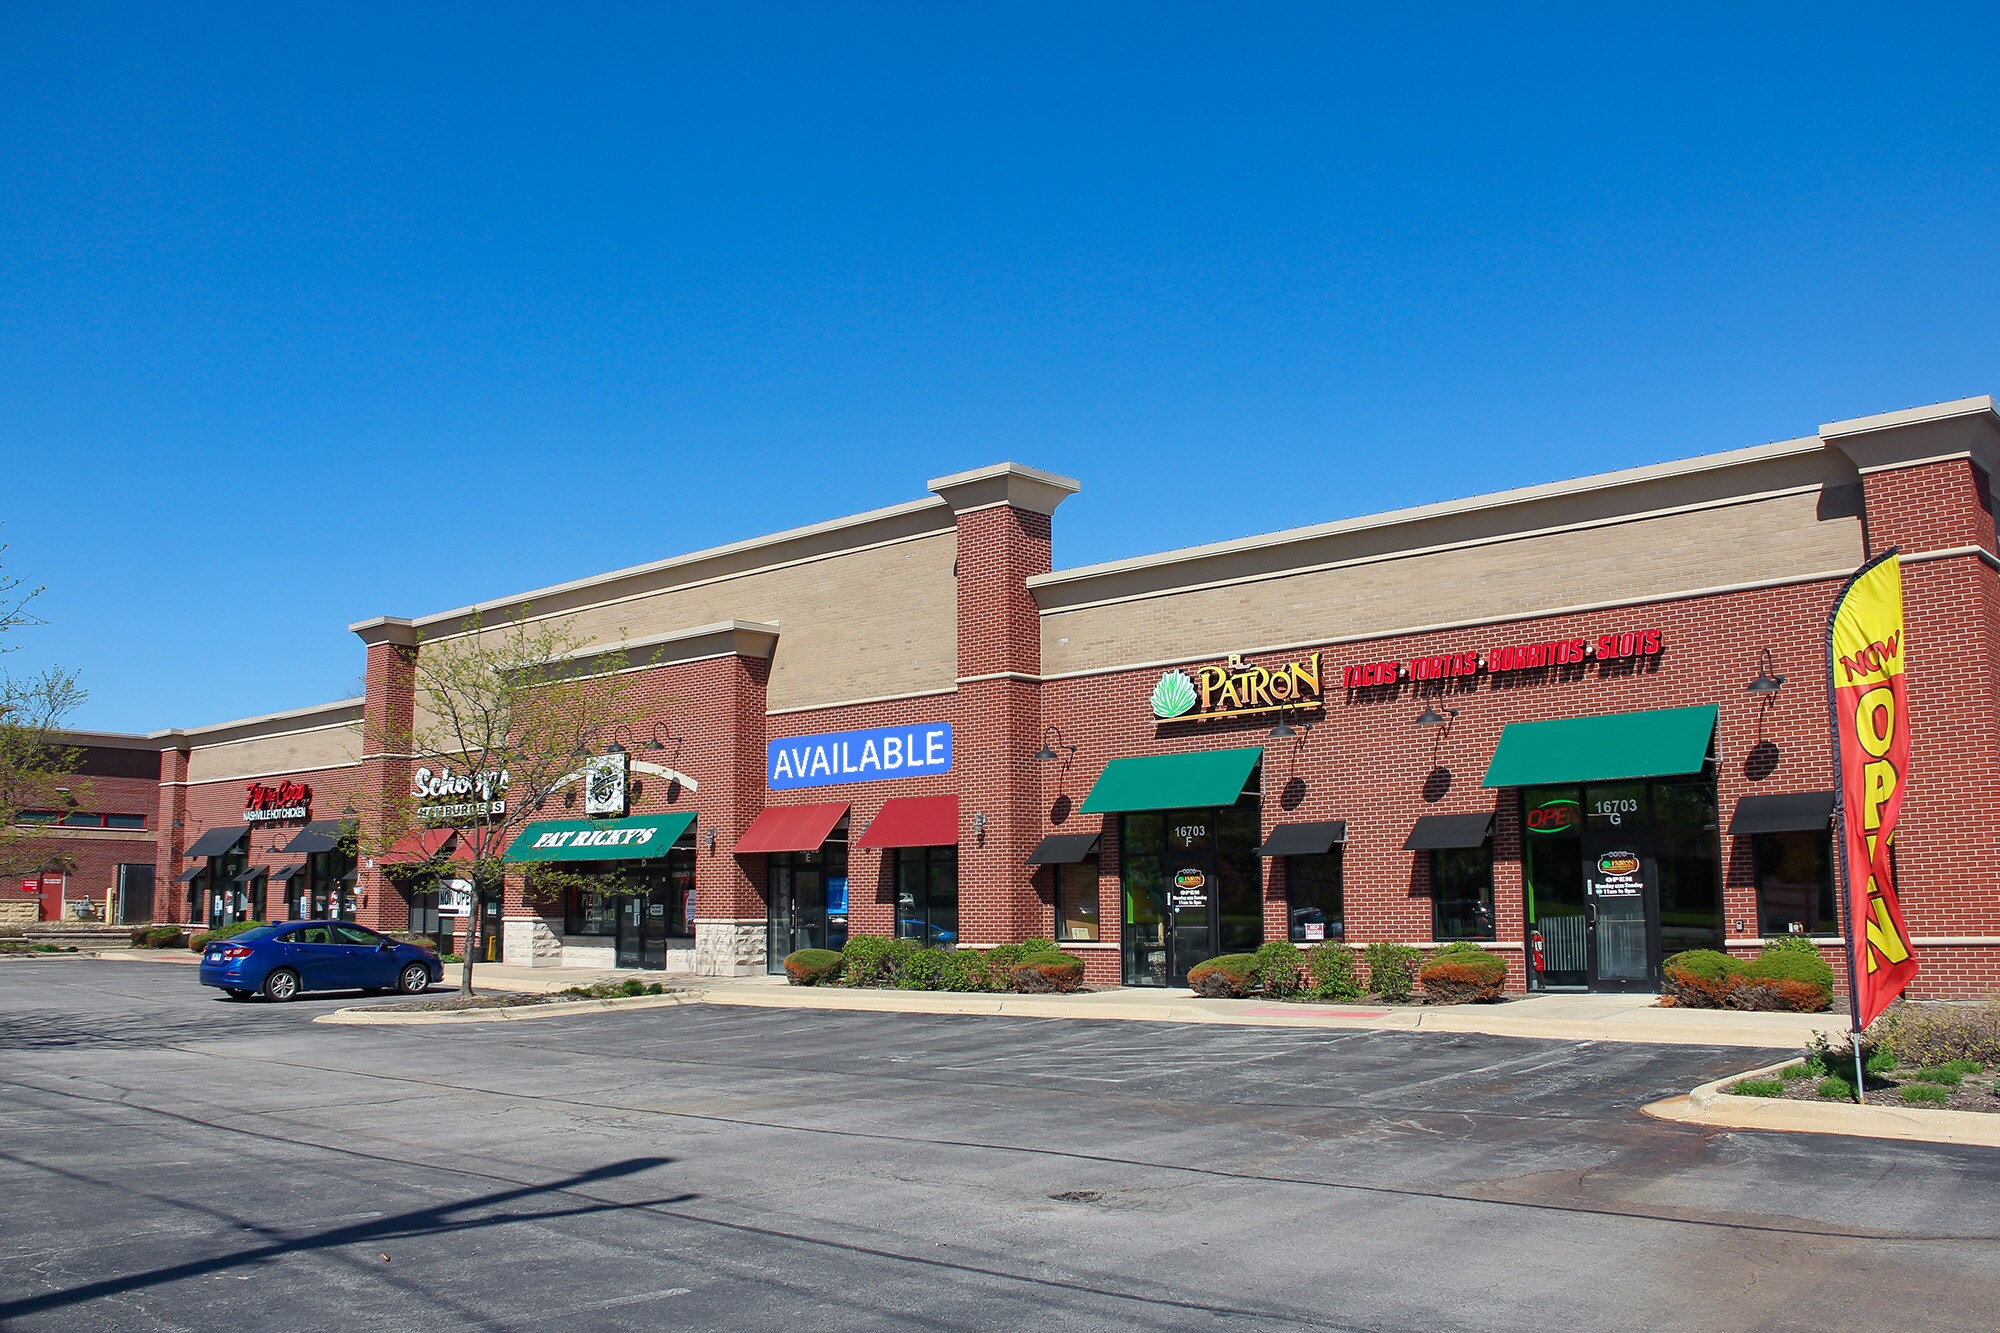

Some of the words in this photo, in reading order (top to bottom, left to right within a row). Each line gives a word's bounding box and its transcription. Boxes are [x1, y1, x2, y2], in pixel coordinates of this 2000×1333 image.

[1228, 653, 1251, 669] EL
[1343, 661, 1399, 689] TACOS
[1409, 651, 1477, 682] TORTAS
[1488, 639, 1586, 673] BURRITOS
[1597, 629, 1662, 660] SLOTS
[1839, 629, 1900, 683] NOW
[244, 783, 264, 810] Fry
[277, 780, 305, 806] Coop
[243, 809, 271, 821] NASHVILLE
[271, 808, 282, 819] HOT
[282, 806, 306, 819] CHICKEN
[1595, 799, 1637, 813] 16703
[1610, 812, 1621, 825] G
[532, 830, 576, 848] FAT
[569, 827, 658, 847] RICKY'S
[1175, 825, 1206, 838] 16703
[1185, 836, 1193, 847] F
[642, 859, 647, 867] D
[805, 853, 811, 862] E
[456, 890, 472, 906] OPE
